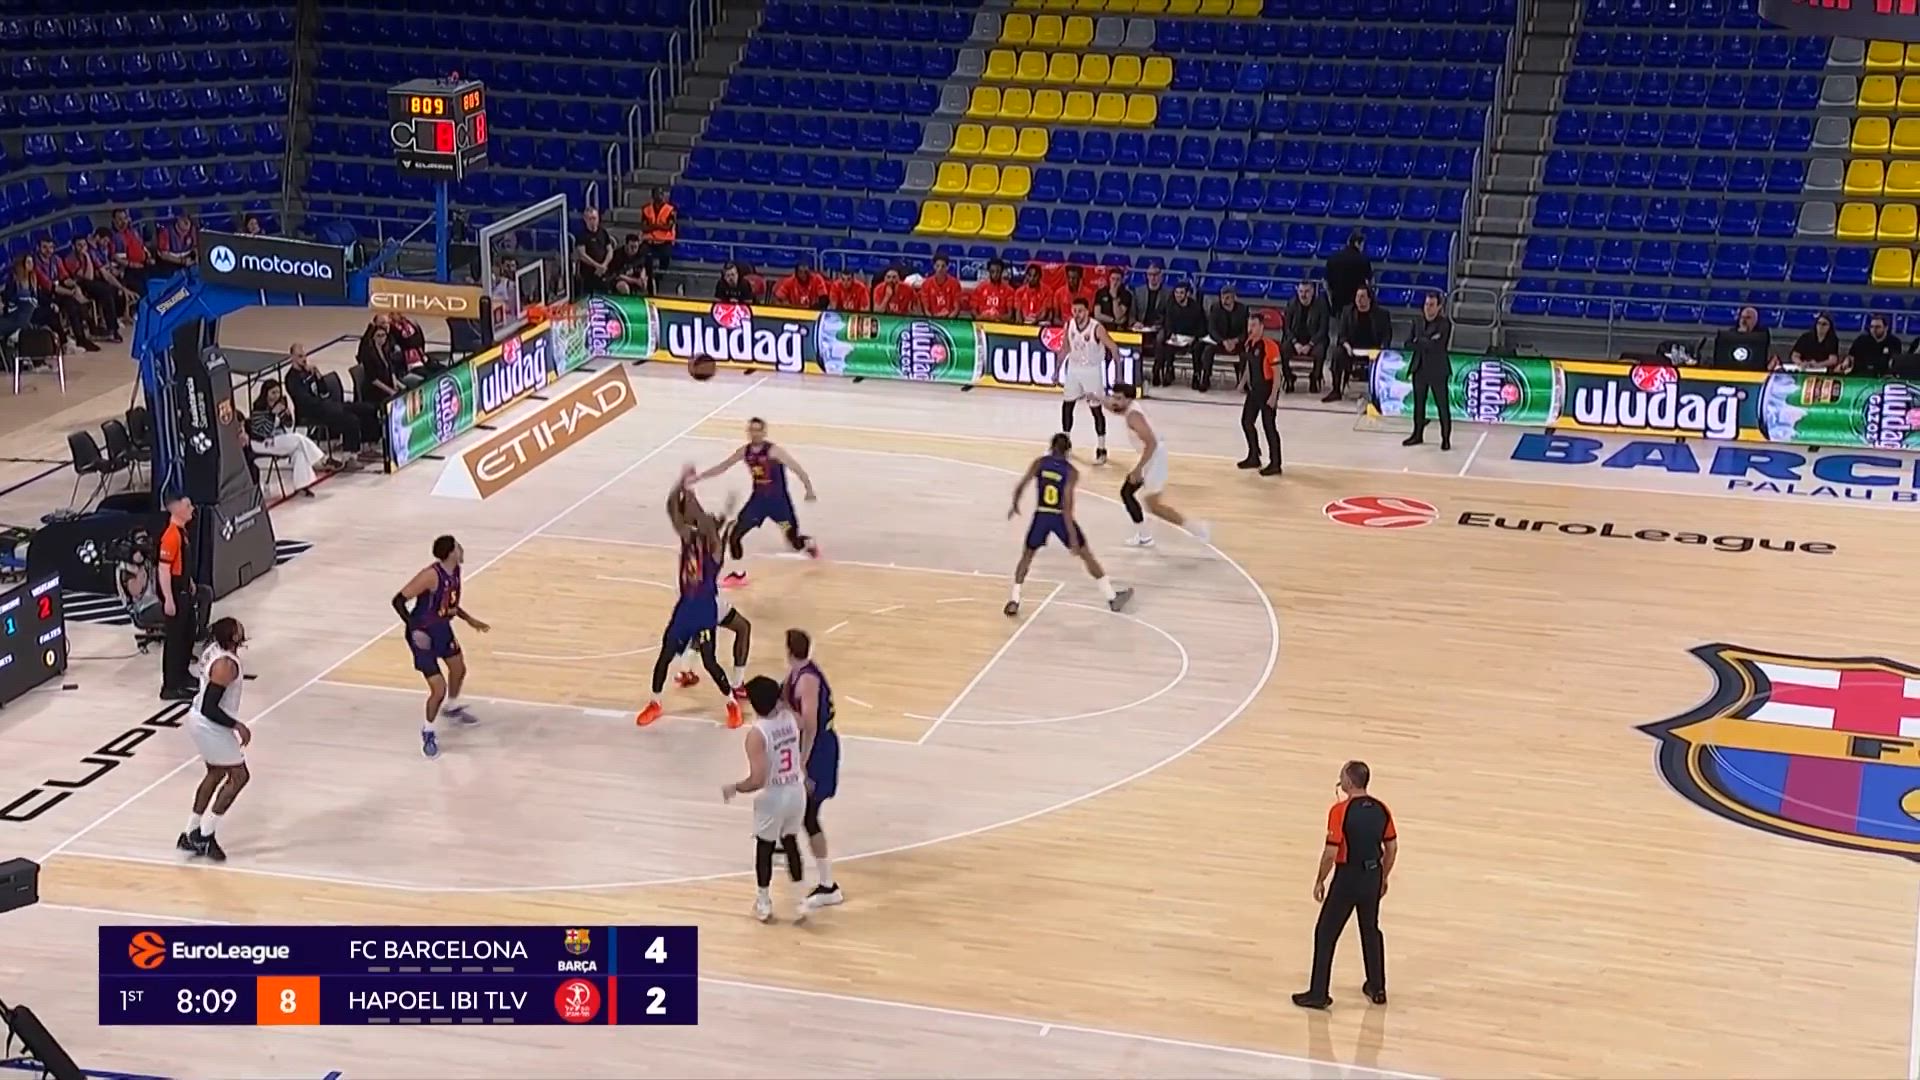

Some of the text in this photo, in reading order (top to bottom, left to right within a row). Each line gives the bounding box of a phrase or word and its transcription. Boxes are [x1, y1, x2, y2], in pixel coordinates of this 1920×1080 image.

[241, 253, 333, 280] motorola
[370, 292, 468, 312] ETIHAD
[481, 337, 548, 413] uludağ
[1574, 381, 1739, 440] uludağ
[476, 380, 628, 482] ETIHAD
[1510, 432, 1920, 488] BARC
[1043, 484, 1059, 506] 0
[1727, 478, 1872, 500] PALAU
[1456, 510, 1838, 556] EuroLeague
[778, 748, 793, 774] 3
